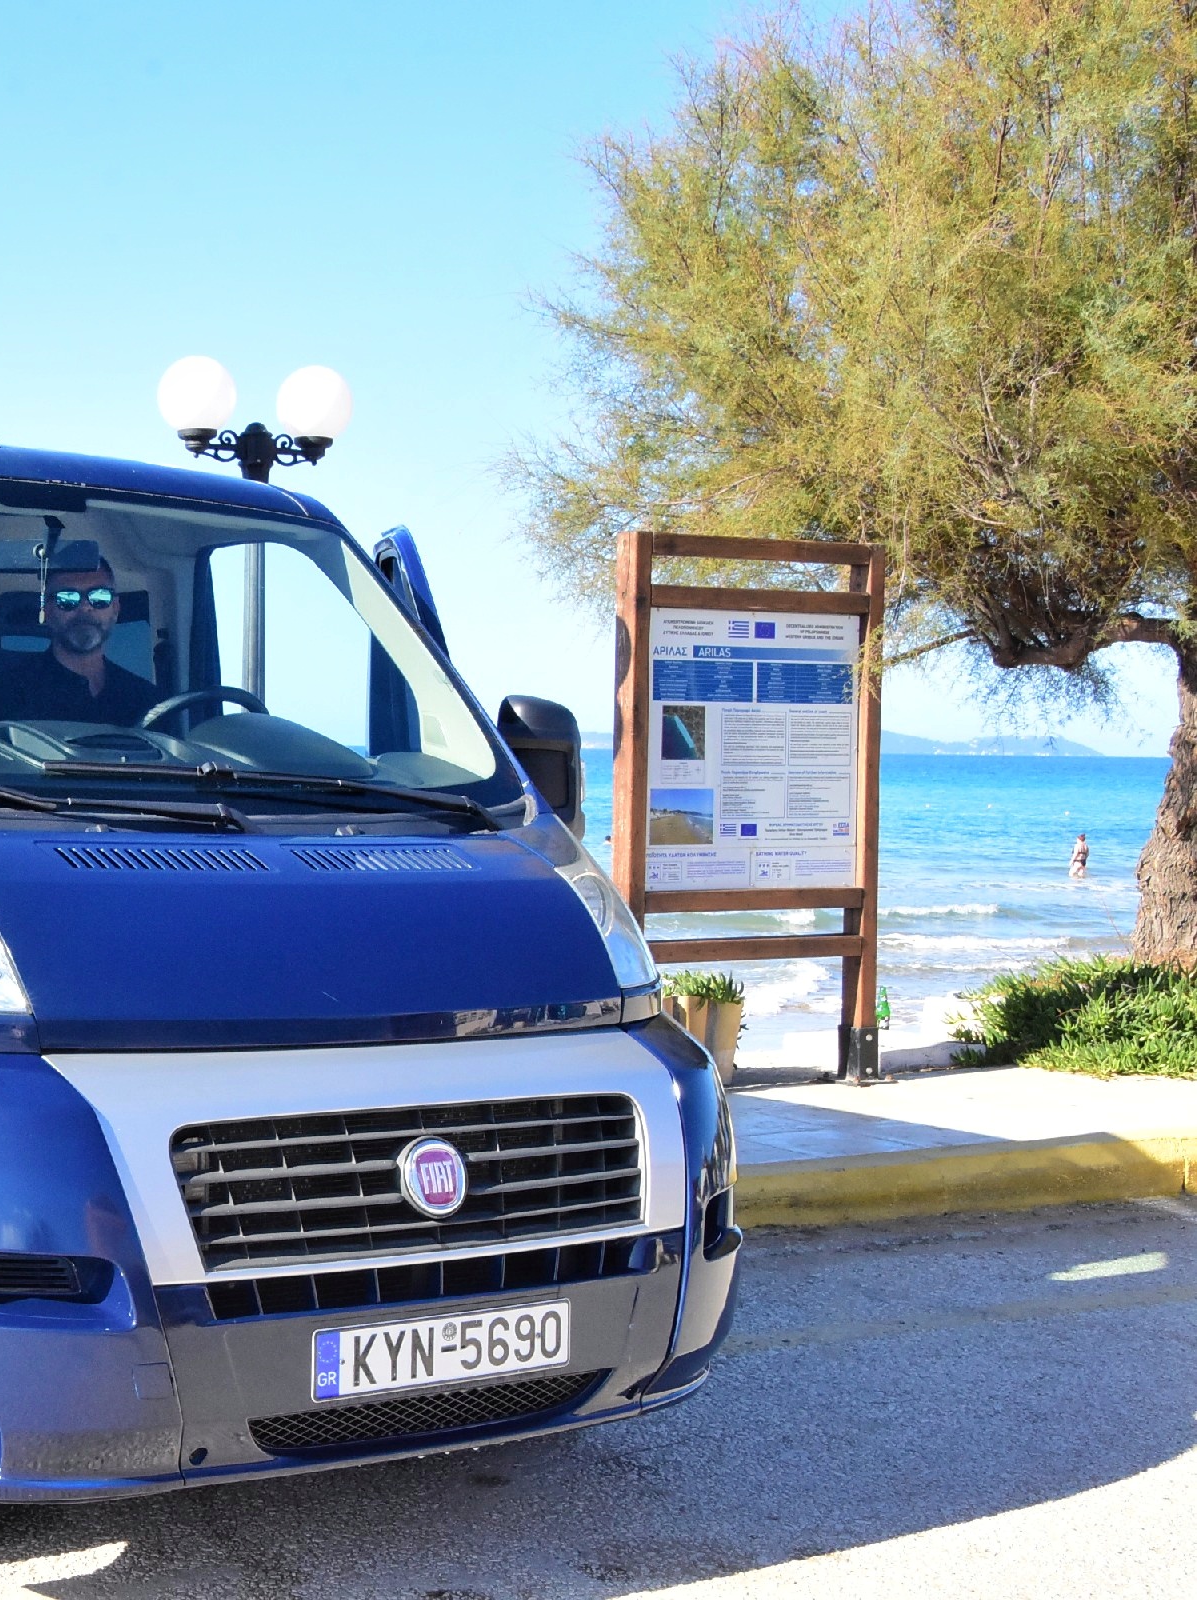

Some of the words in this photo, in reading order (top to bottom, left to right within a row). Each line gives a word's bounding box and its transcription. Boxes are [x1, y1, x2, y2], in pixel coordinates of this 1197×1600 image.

[653, 645, 688, 657] ΑΡΙΛΑΣ
[698, 647, 731, 658] ARILAS
[419, 1160, 454, 1195] FIAT
[352, 1310, 562, 1387] KYN-5690
[317, 1371, 337, 1387] GR
